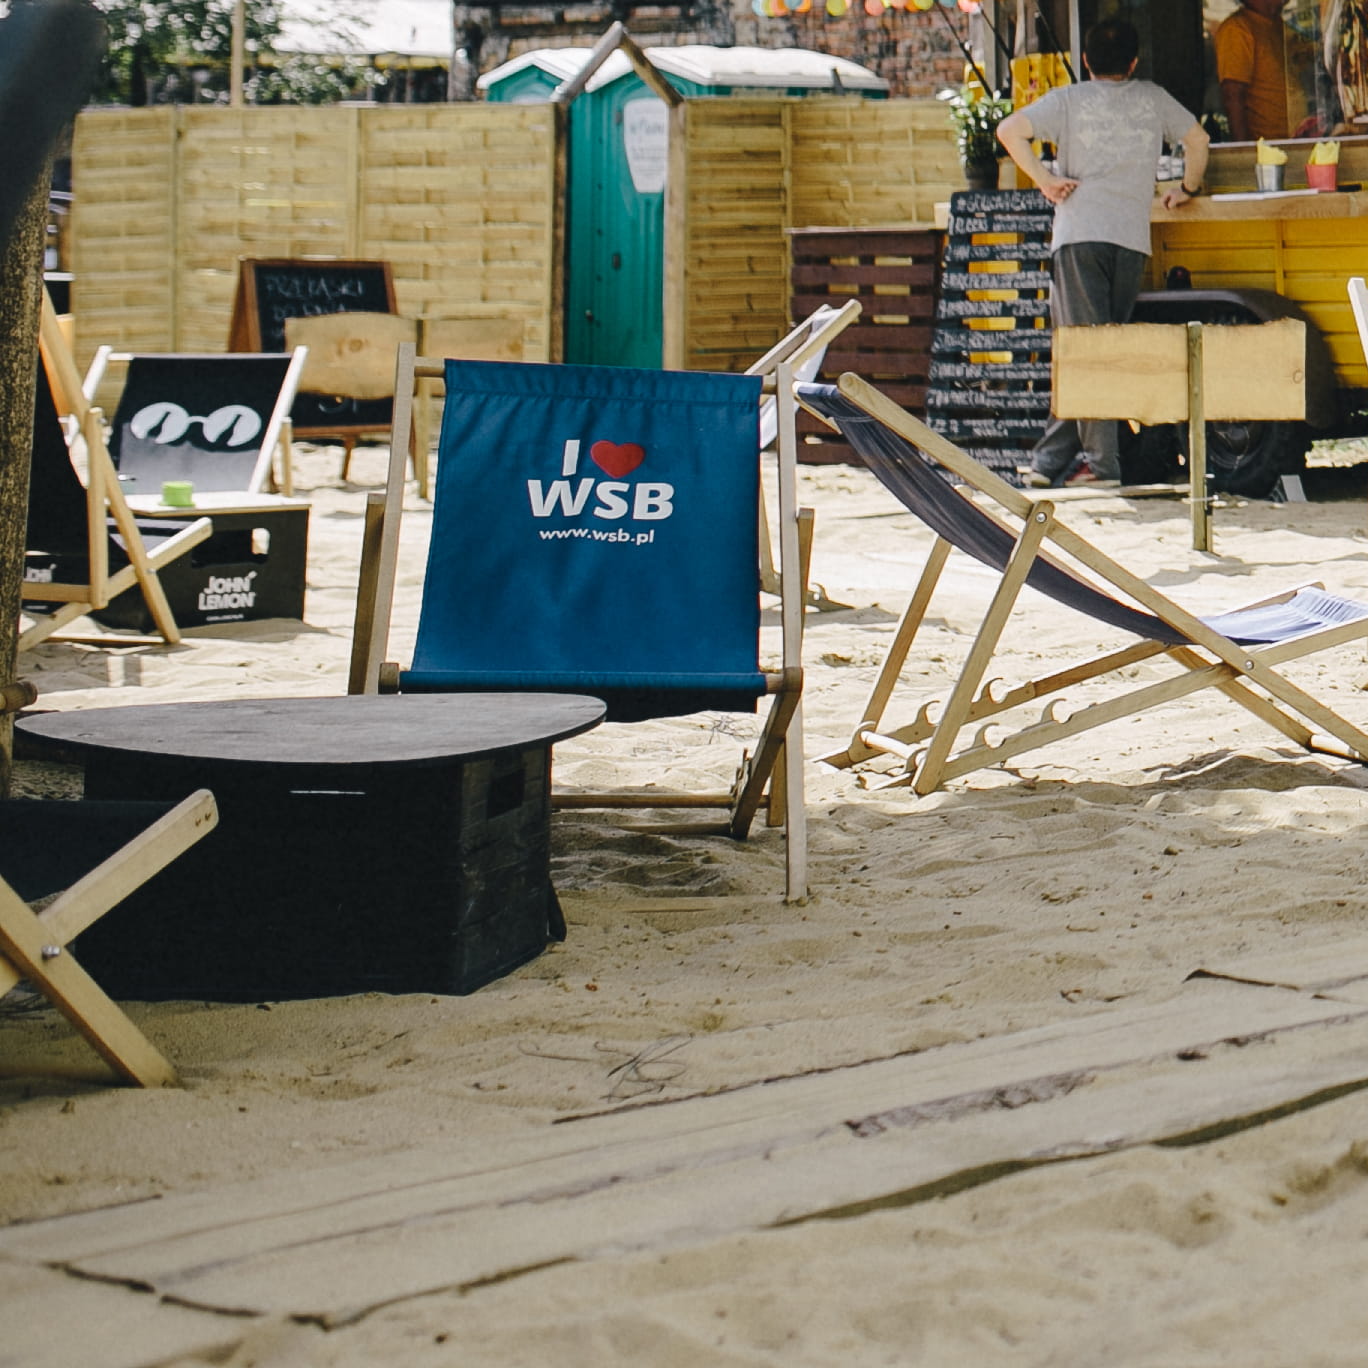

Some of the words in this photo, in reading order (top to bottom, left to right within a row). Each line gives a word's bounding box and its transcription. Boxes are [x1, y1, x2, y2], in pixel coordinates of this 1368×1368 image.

[561, 439, 581, 477] I
[527, 477, 675, 520] WSB
[539, 528, 655, 546] www.wsb.pl
[203, 575, 252, 595] JOHN
[198, 592, 255, 611] LEMON
